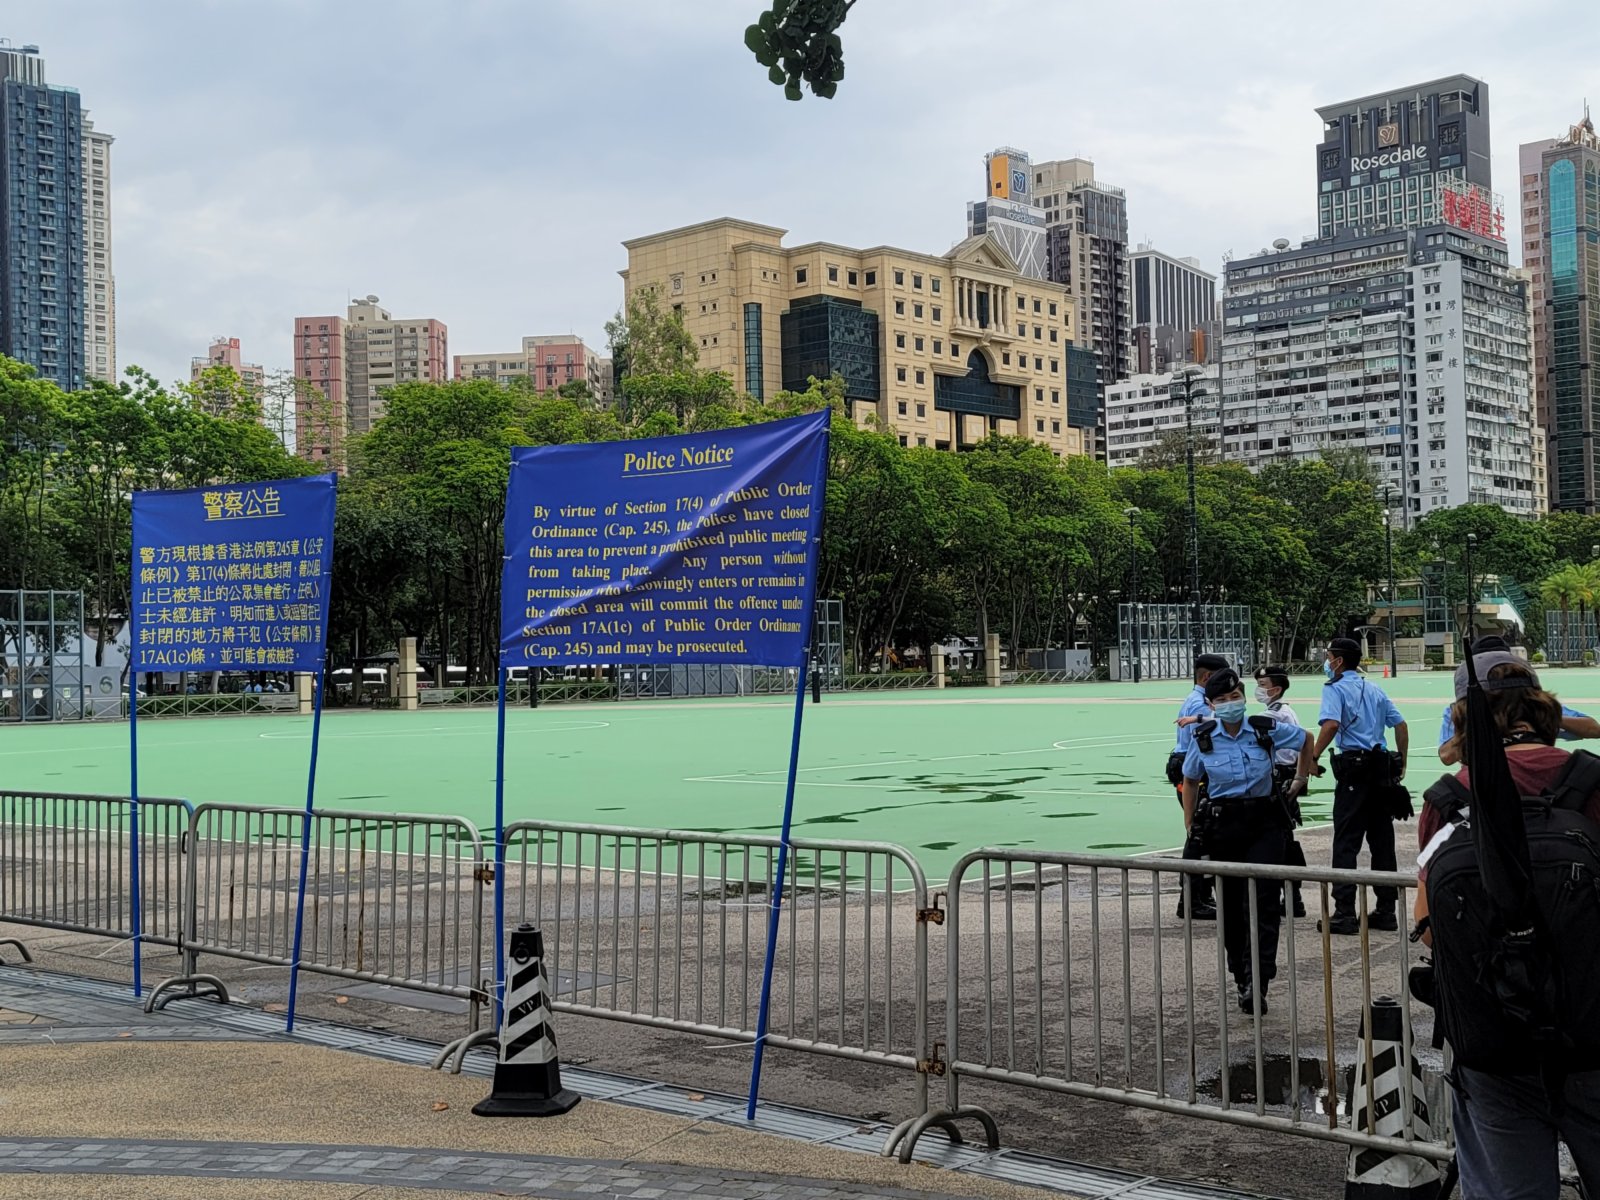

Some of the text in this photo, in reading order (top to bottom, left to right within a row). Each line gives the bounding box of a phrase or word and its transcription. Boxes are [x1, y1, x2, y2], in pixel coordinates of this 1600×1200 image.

[1351, 144, 1427, 172] Rosedale
[622, 443, 735, 472] Police Notice
[202, 486, 281, 519] 警察公告
[534, 481, 813, 521] By virtue of Section 17(4) of Public Order
[531, 504, 810, 540] Ordinance (Cap. 245), the Police have closed
[529, 528, 808, 561] this area to prevent a prohibited public meeting
[528, 550, 807, 581] from taking place. Any person without
[526, 572, 805, 602] permission who owingly enters or remains in
[525, 595, 803, 619] the closed area will commit the offence under
[522, 617, 801, 638] Section 17A(1c) of Public Order Ordinance
[524, 639, 748, 660] (Cap. 245) and may be prosecuted.
[1082, 655, 1088, 668] 4
[99, 675, 114, 695] 6
[518, 999, 535, 1015] VP
